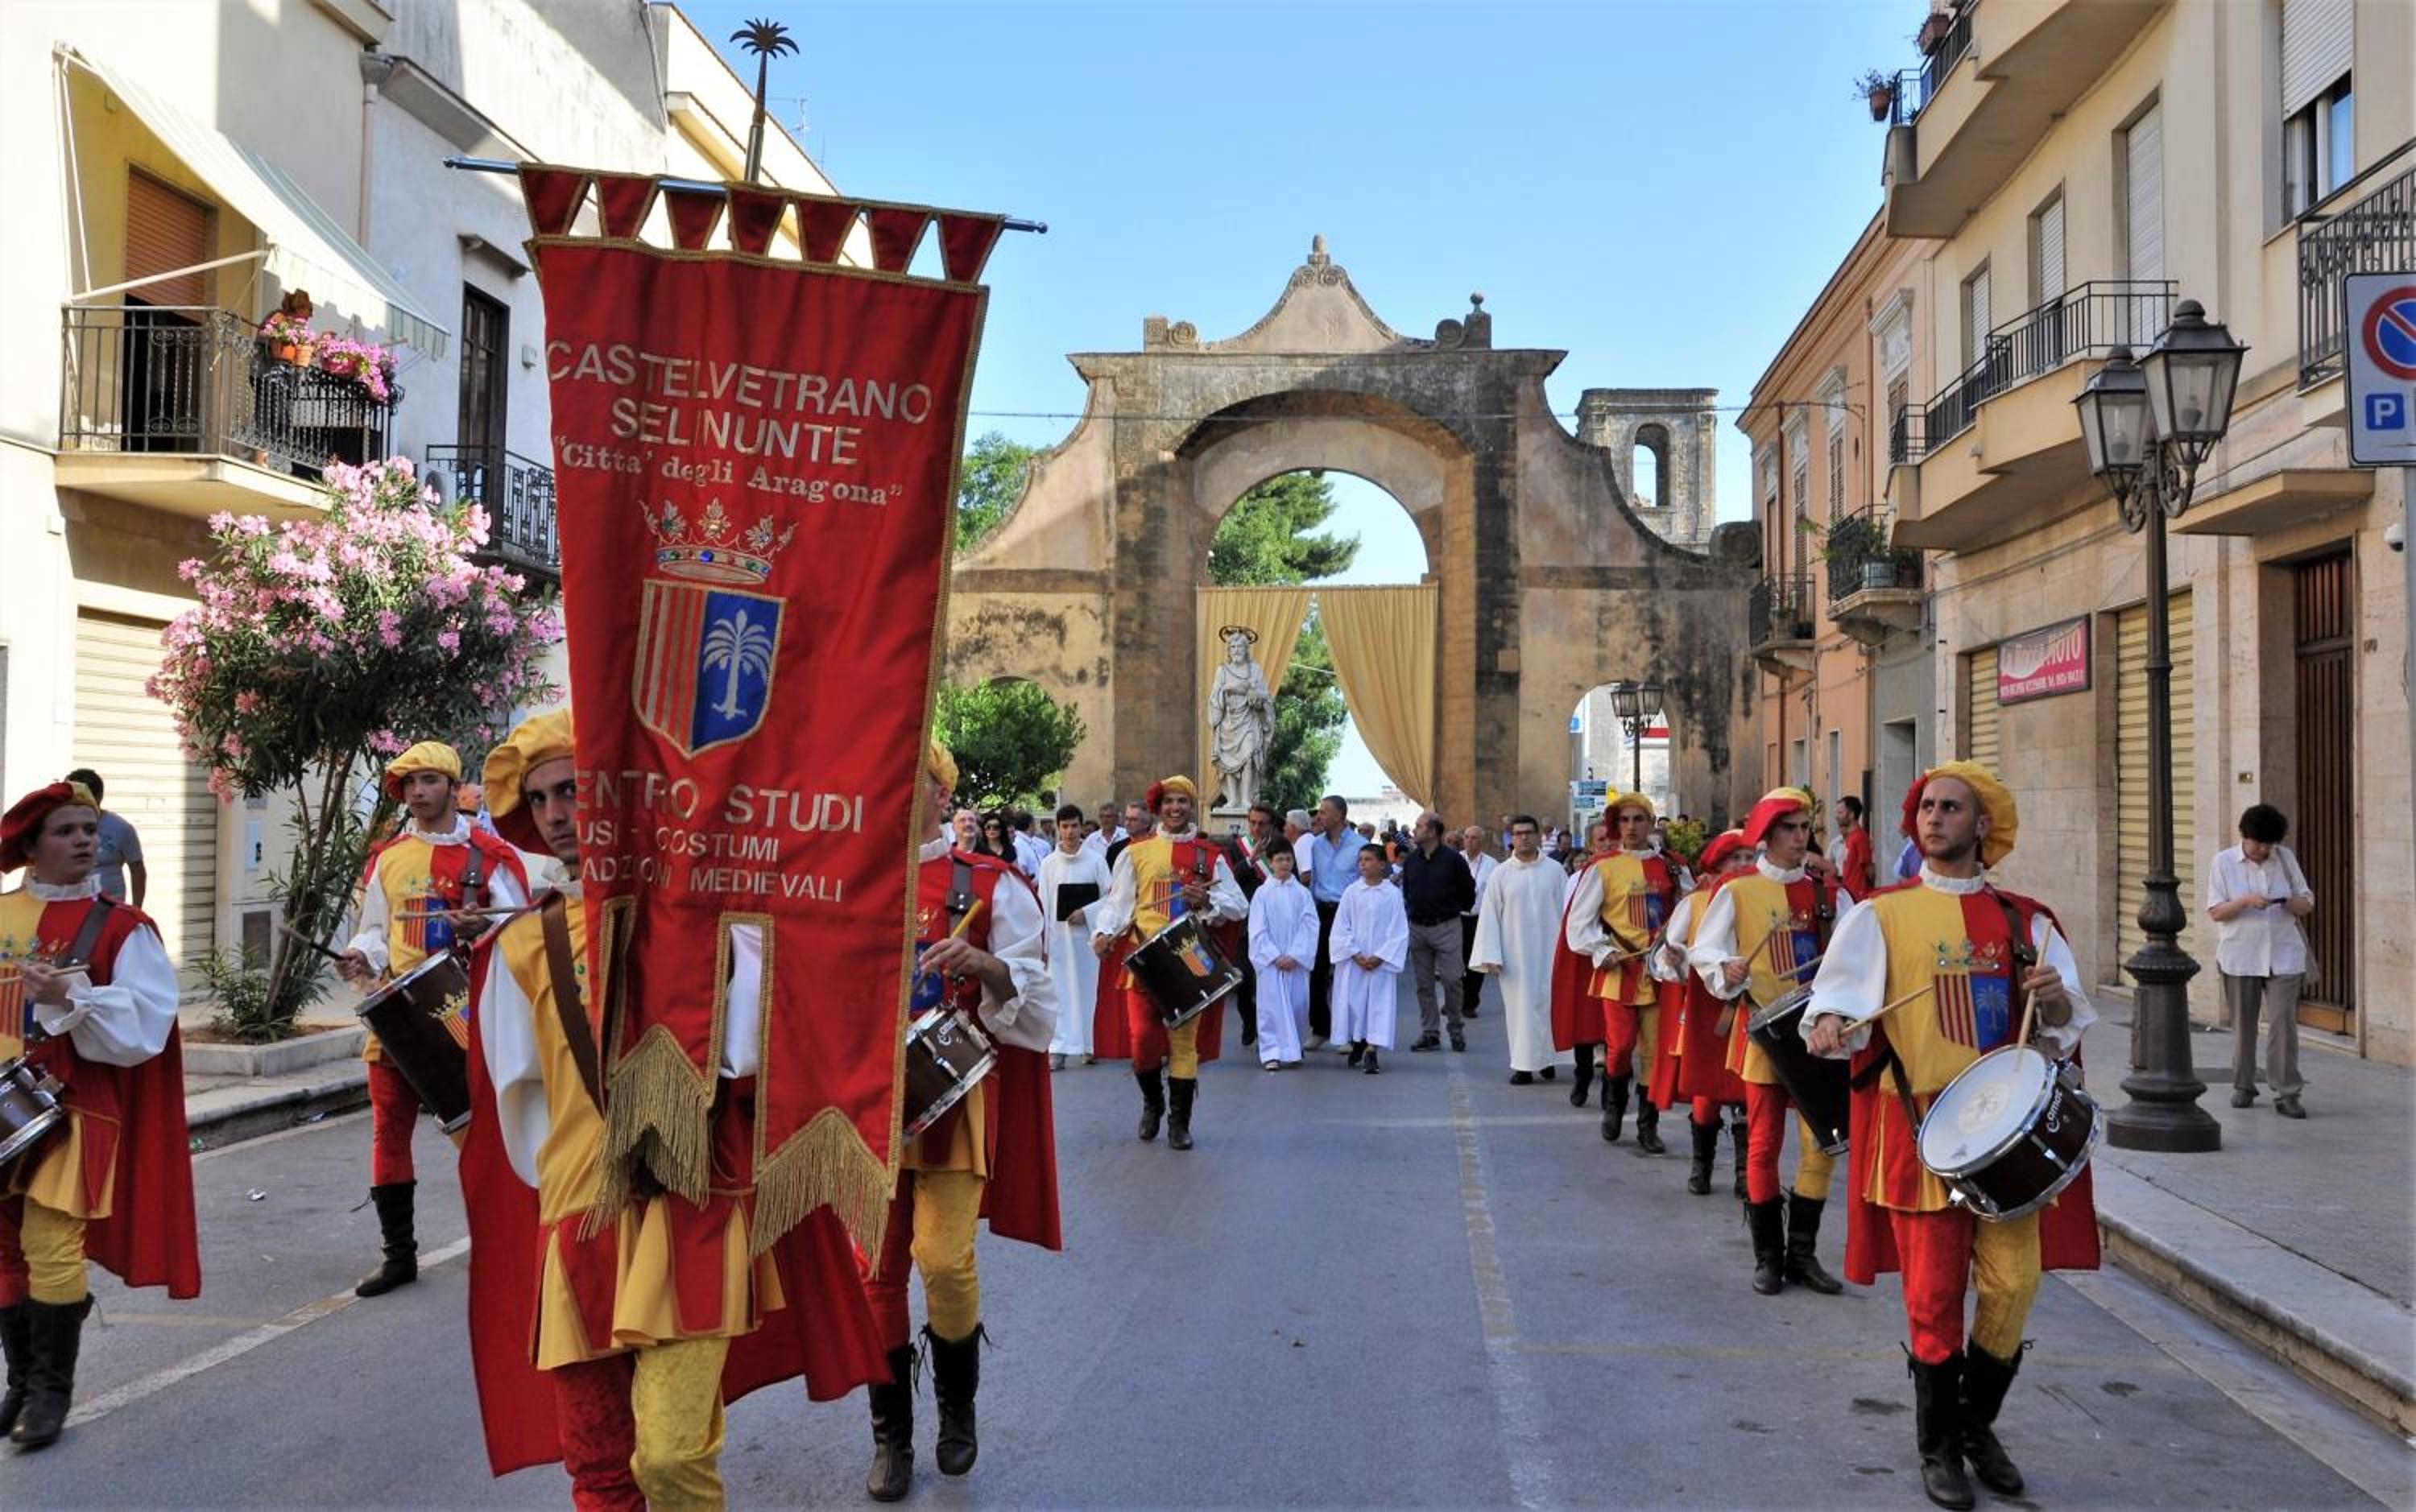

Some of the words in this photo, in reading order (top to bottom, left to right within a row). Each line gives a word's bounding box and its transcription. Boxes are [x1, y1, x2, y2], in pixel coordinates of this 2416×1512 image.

[547, 340, 932, 424] CASTELVETRANO
[611, 398, 863, 465] SELINUNTE
[2374, 399, 2397, 426] P
[661, 456, 734, 487] degli
[575, 770, 700, 820] ENTRO
[724, 784, 863, 833] STUDI
[577, 819, 618, 845] USI
[656, 827, 780, 862] COSTUMI
[690, 866, 842, 903] MEDIEVALI
